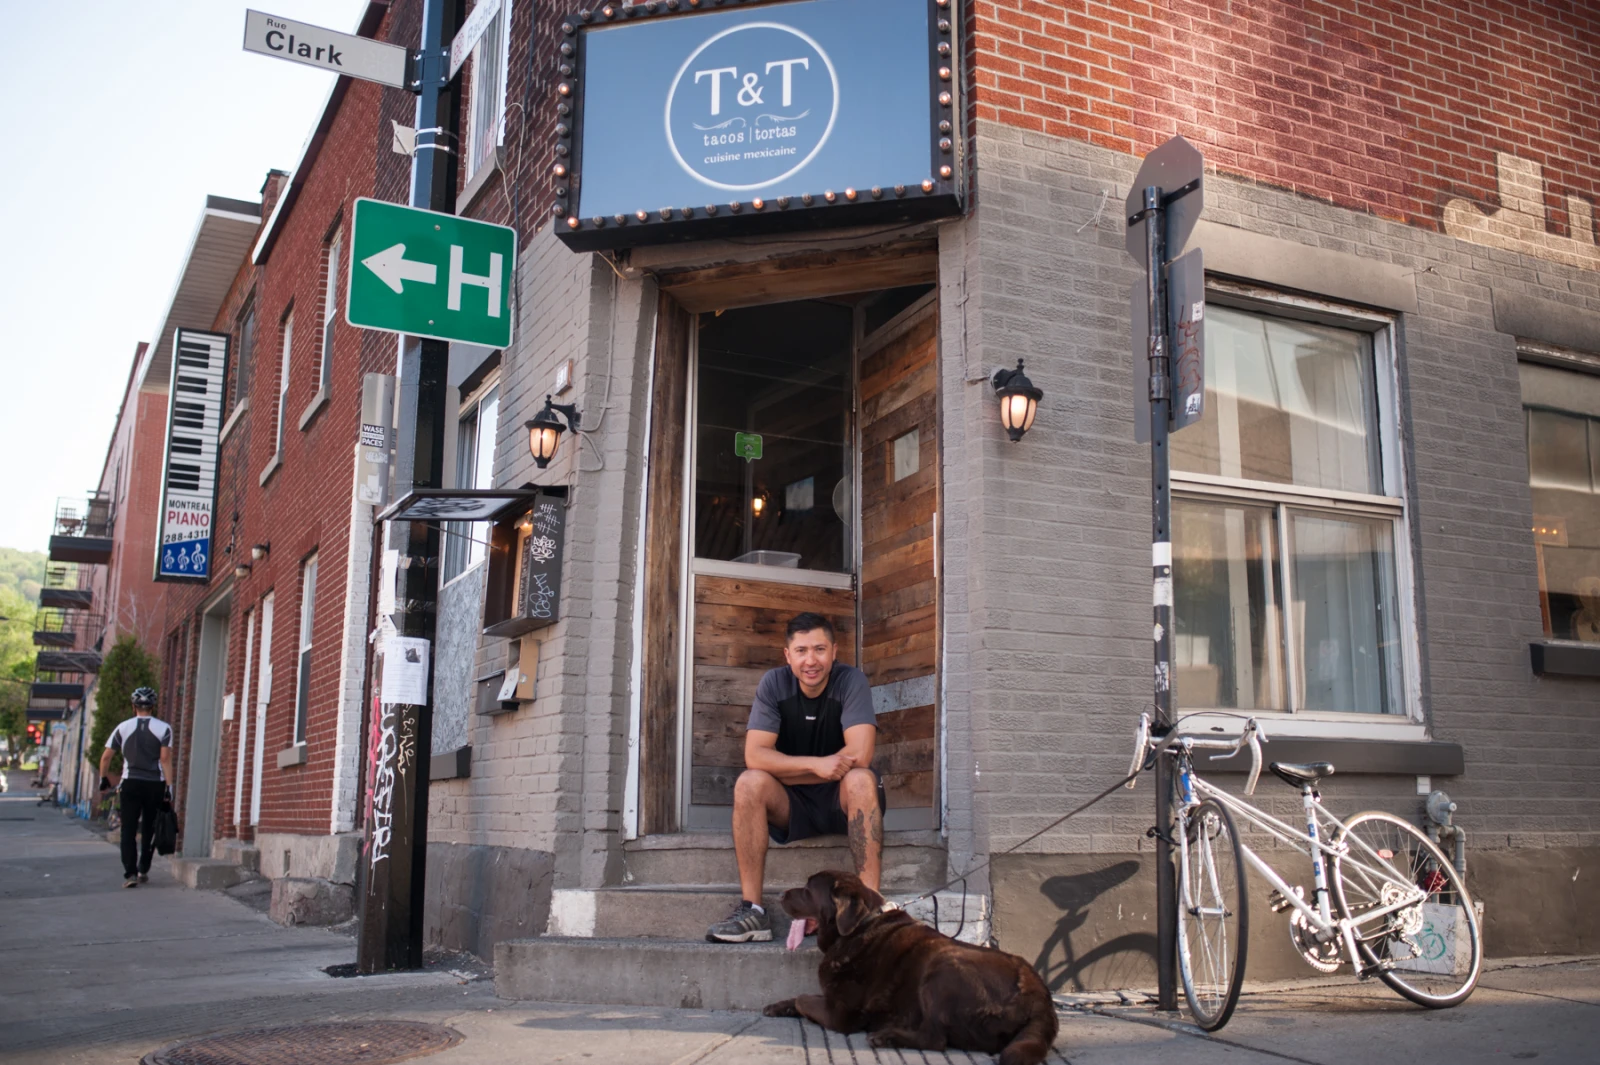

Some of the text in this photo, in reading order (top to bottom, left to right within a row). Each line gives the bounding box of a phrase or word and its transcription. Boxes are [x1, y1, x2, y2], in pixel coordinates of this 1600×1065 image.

[266, 18, 287, 30] Rue
[265, 30, 343, 66] Clark
[694, 57, 809, 116] T&T
[703, 126, 797, 146] tacos tortas
[704, 146, 797, 164] cuisine mexicaine
[447, 244, 503, 318] H
[168, 500, 210, 511] MONTREAL
[168, 511, 209, 526] PIANO
[165, 530, 208, 542] 288-4311
